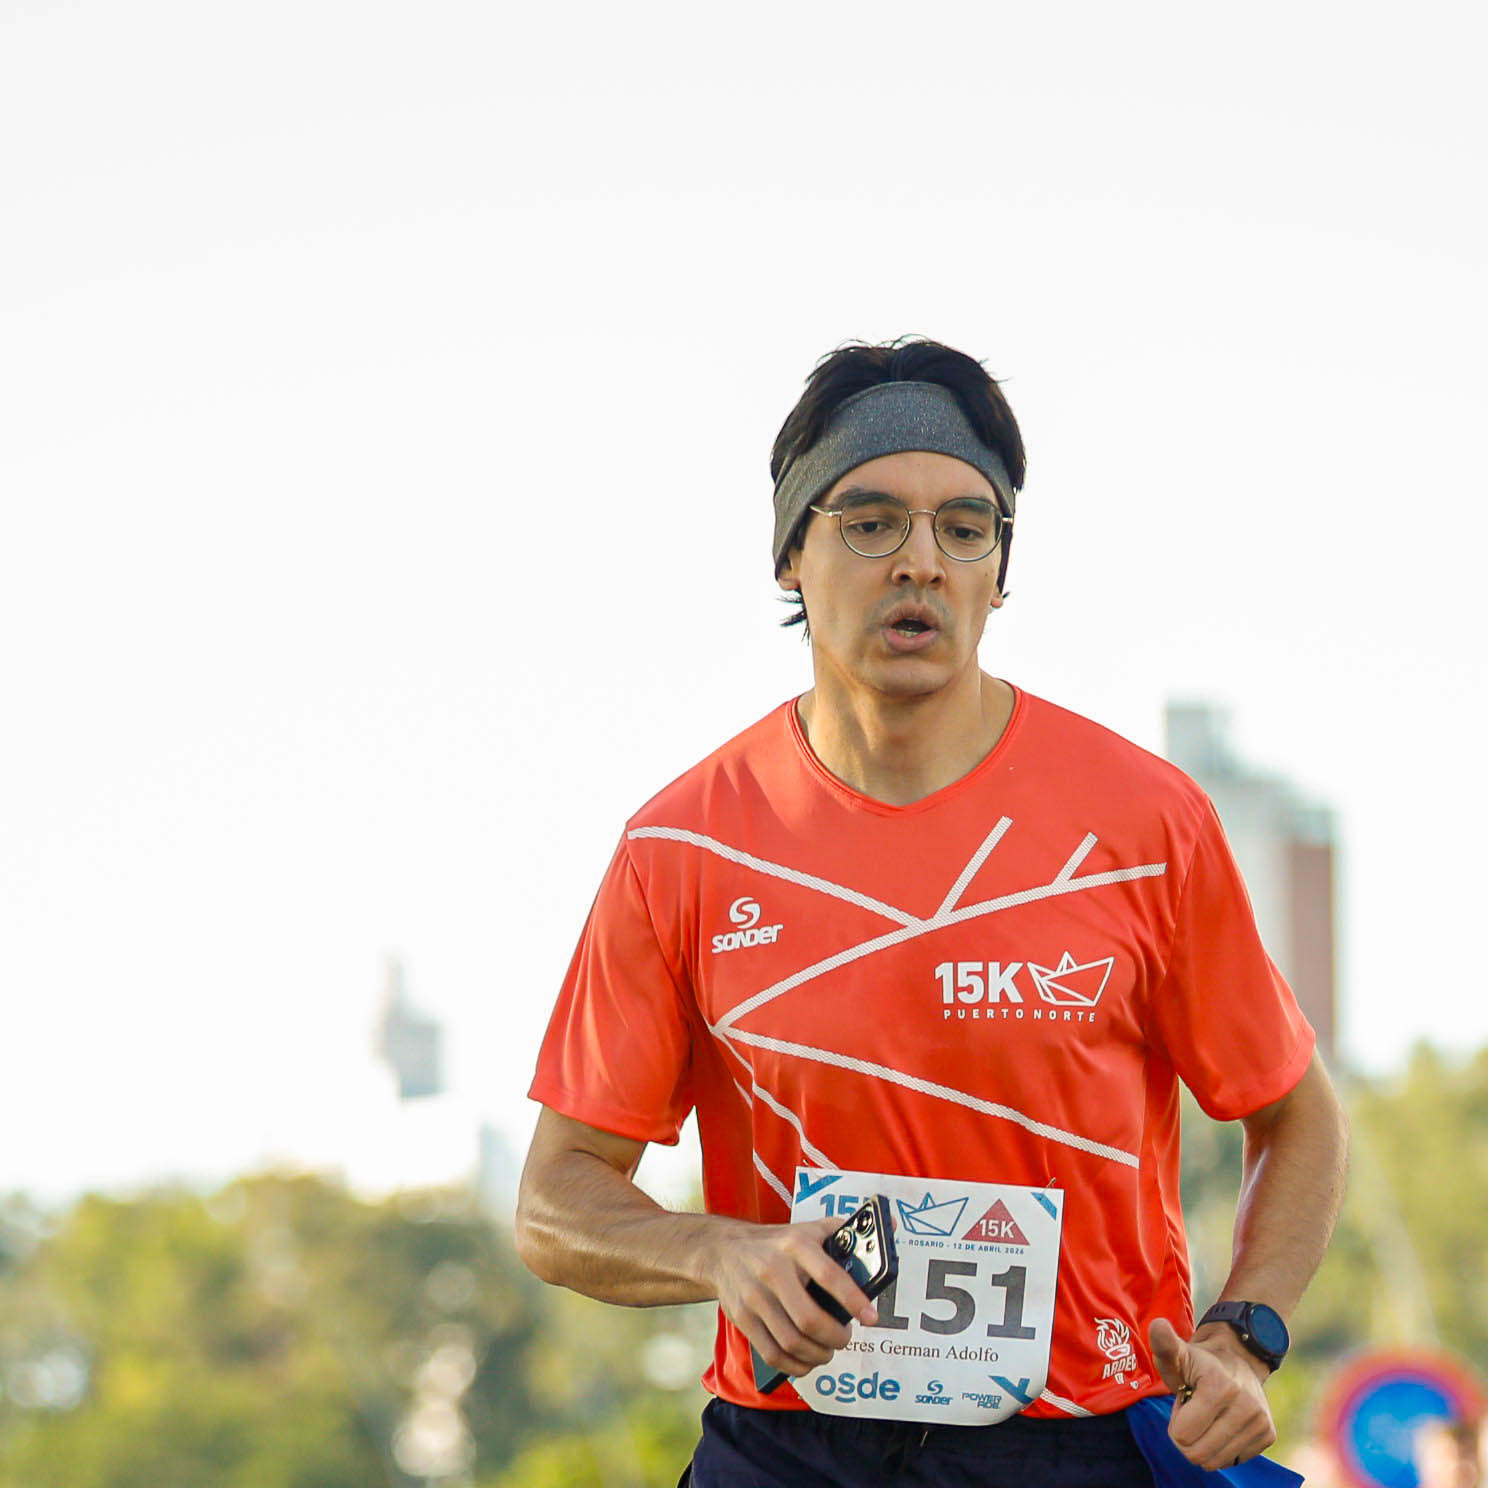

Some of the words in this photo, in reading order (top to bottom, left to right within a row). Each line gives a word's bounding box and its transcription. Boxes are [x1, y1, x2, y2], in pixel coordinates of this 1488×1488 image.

[934, 961, 1024, 1004] 15K
[943, 1008, 1025, 1020] PUERTO
[1033, 1009, 1097, 1023] NORTE
[820, 1194, 870, 1217] 15
[978, 1219, 1017, 1238] 15K
[908, 1239, 944, 1249] ROSARIO
[978, 1244, 1002, 1254] ABRIL
[838, 1340, 875, 1353] eres
[879, 1340, 940, 1358] German
[945, 1345, 999, 1362] Adolfo
